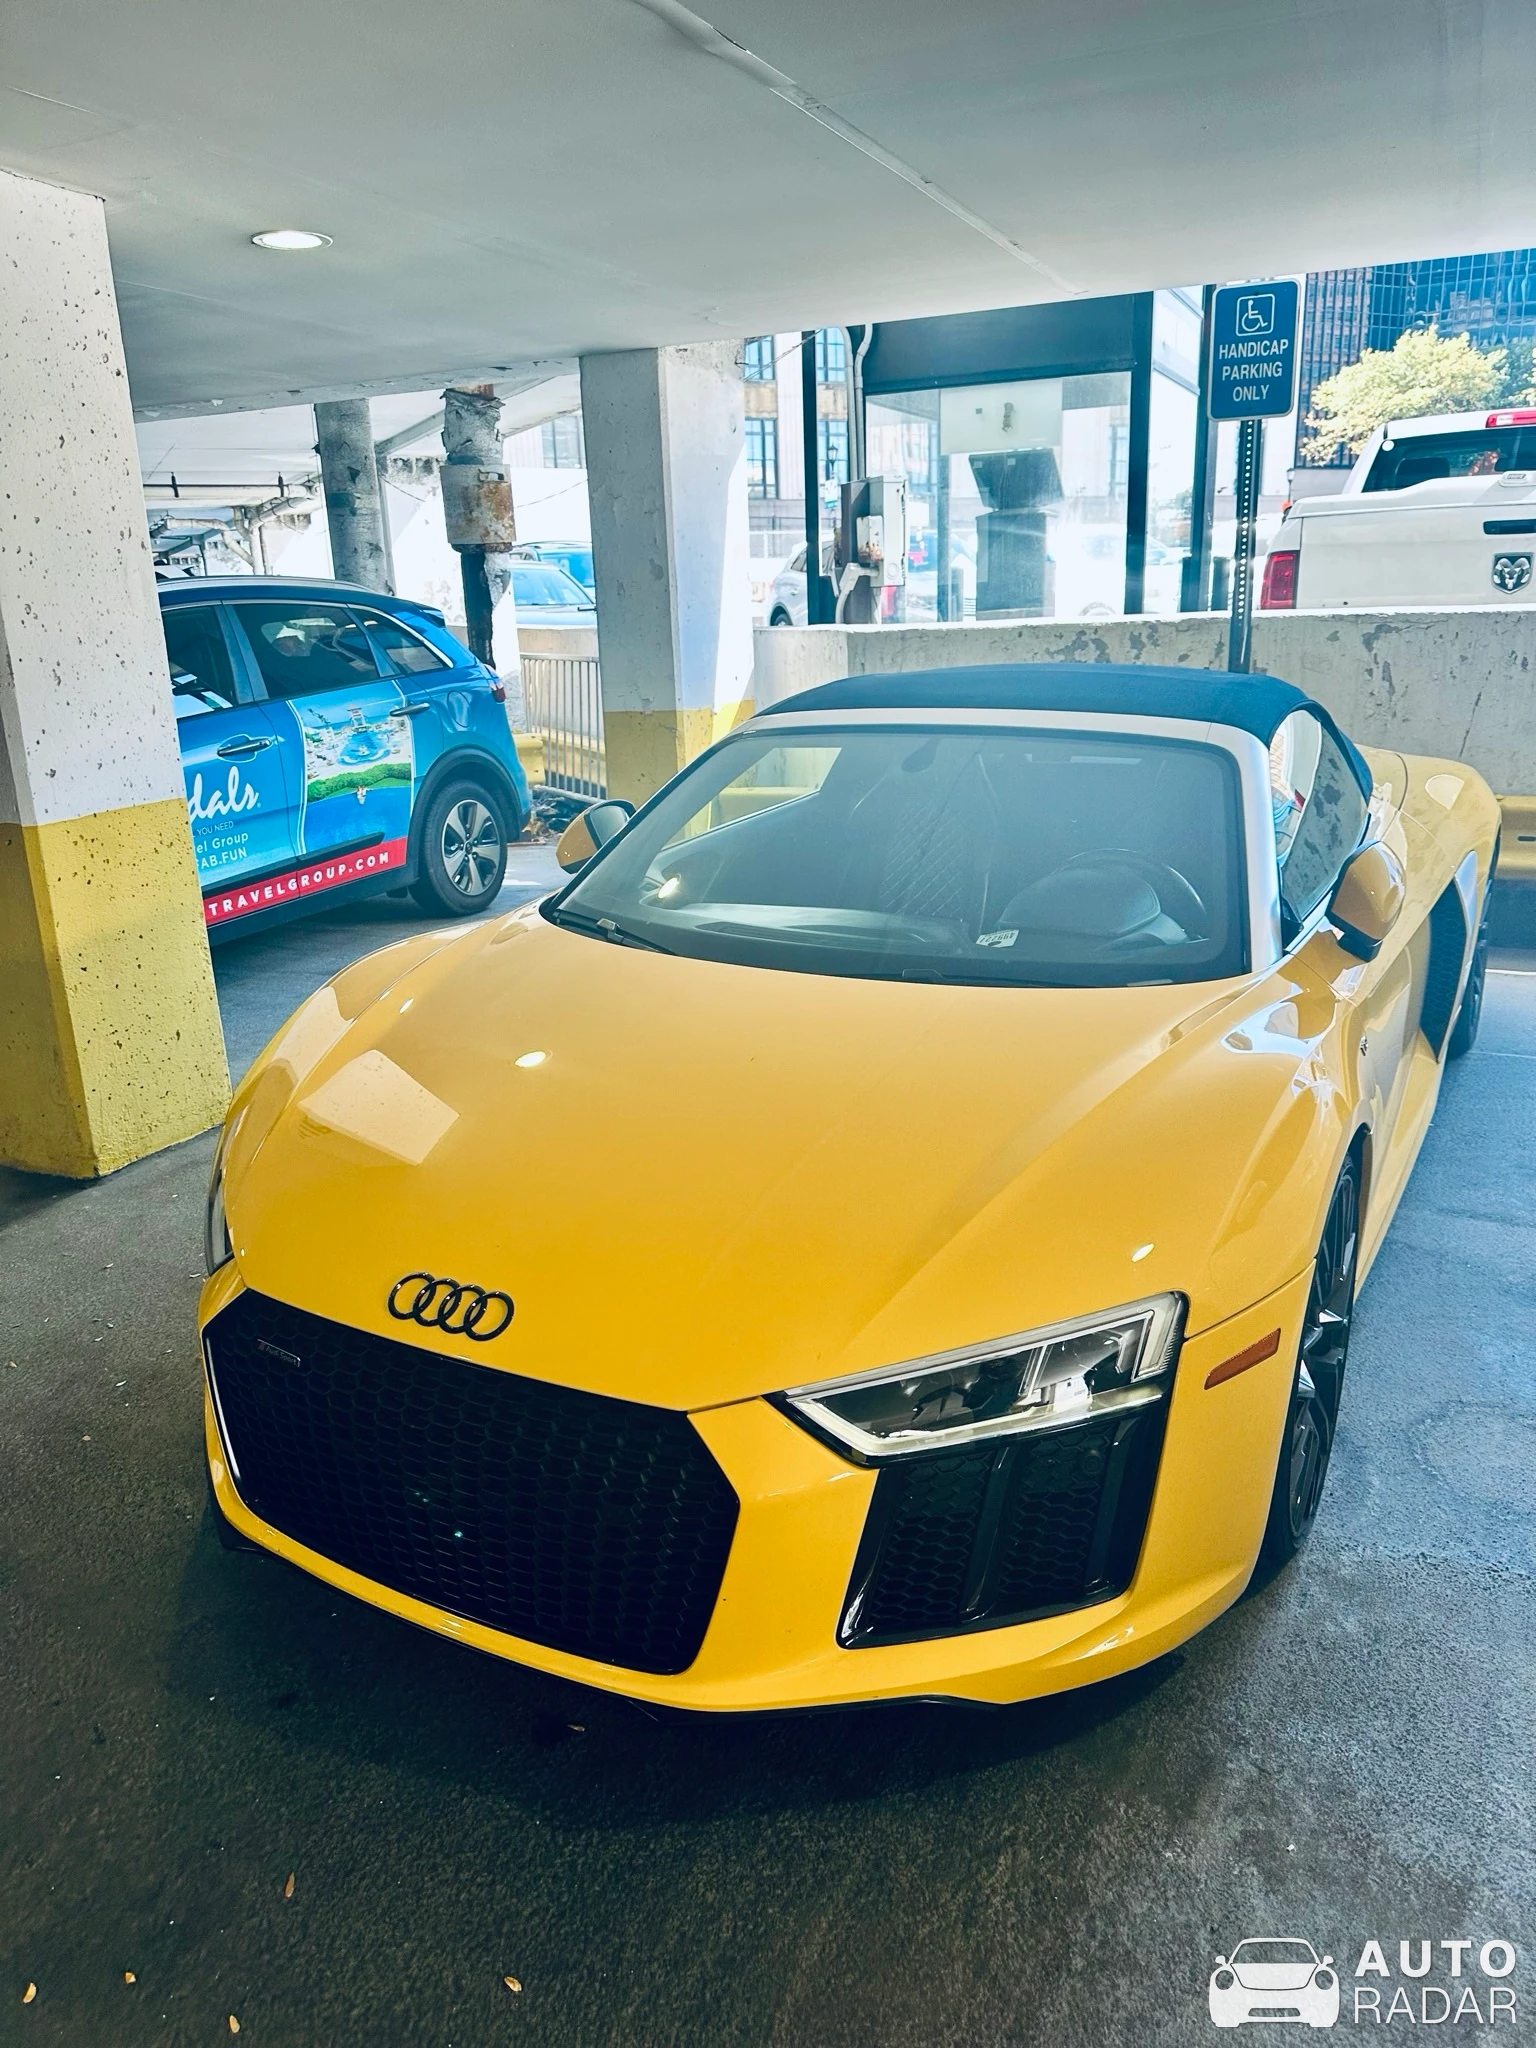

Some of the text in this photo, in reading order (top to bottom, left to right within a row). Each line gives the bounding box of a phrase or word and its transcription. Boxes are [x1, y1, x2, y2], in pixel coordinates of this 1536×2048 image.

[1219, 339, 1289, 359] HANDICAP
[1222, 362, 1283, 381] PARKING
[1232, 384, 1270, 402] ONLY
[196, 826, 213, 836] YOU
[214, 820, 235, 832] NEED
[212, 832, 249, 849] Group
[208, 851, 390, 916] TRAVELGROUP.COM
